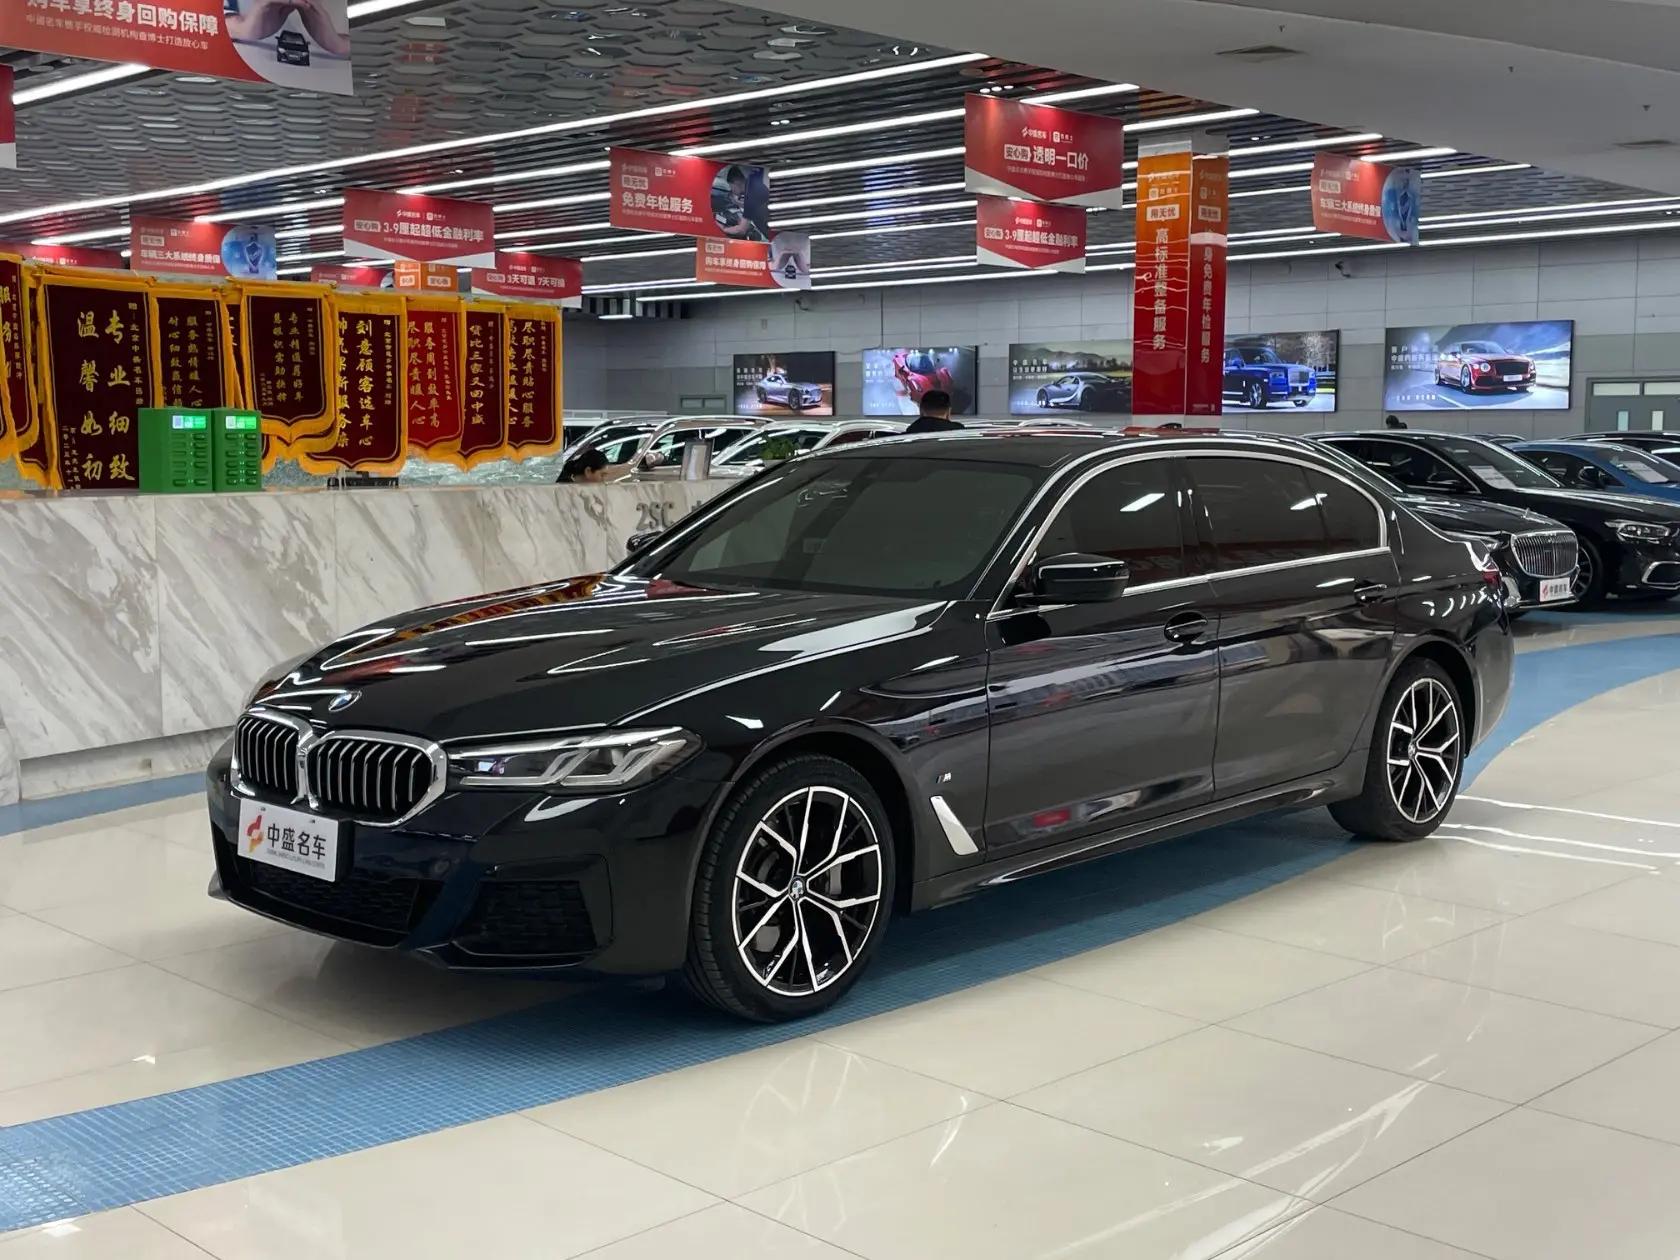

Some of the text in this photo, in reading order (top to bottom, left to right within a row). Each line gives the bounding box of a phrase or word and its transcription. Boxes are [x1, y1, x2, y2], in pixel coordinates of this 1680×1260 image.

[1033, 145, 1088, 170] 透明一口价
[622, 191, 694, 214] 免费年检服务
[1150, 207, 1176, 218] 用无忧
[77, 311, 103, 481] 温馨如初
[105, 309, 136, 481] 专业细致
[267, 823, 327, 861] 中盛名车
